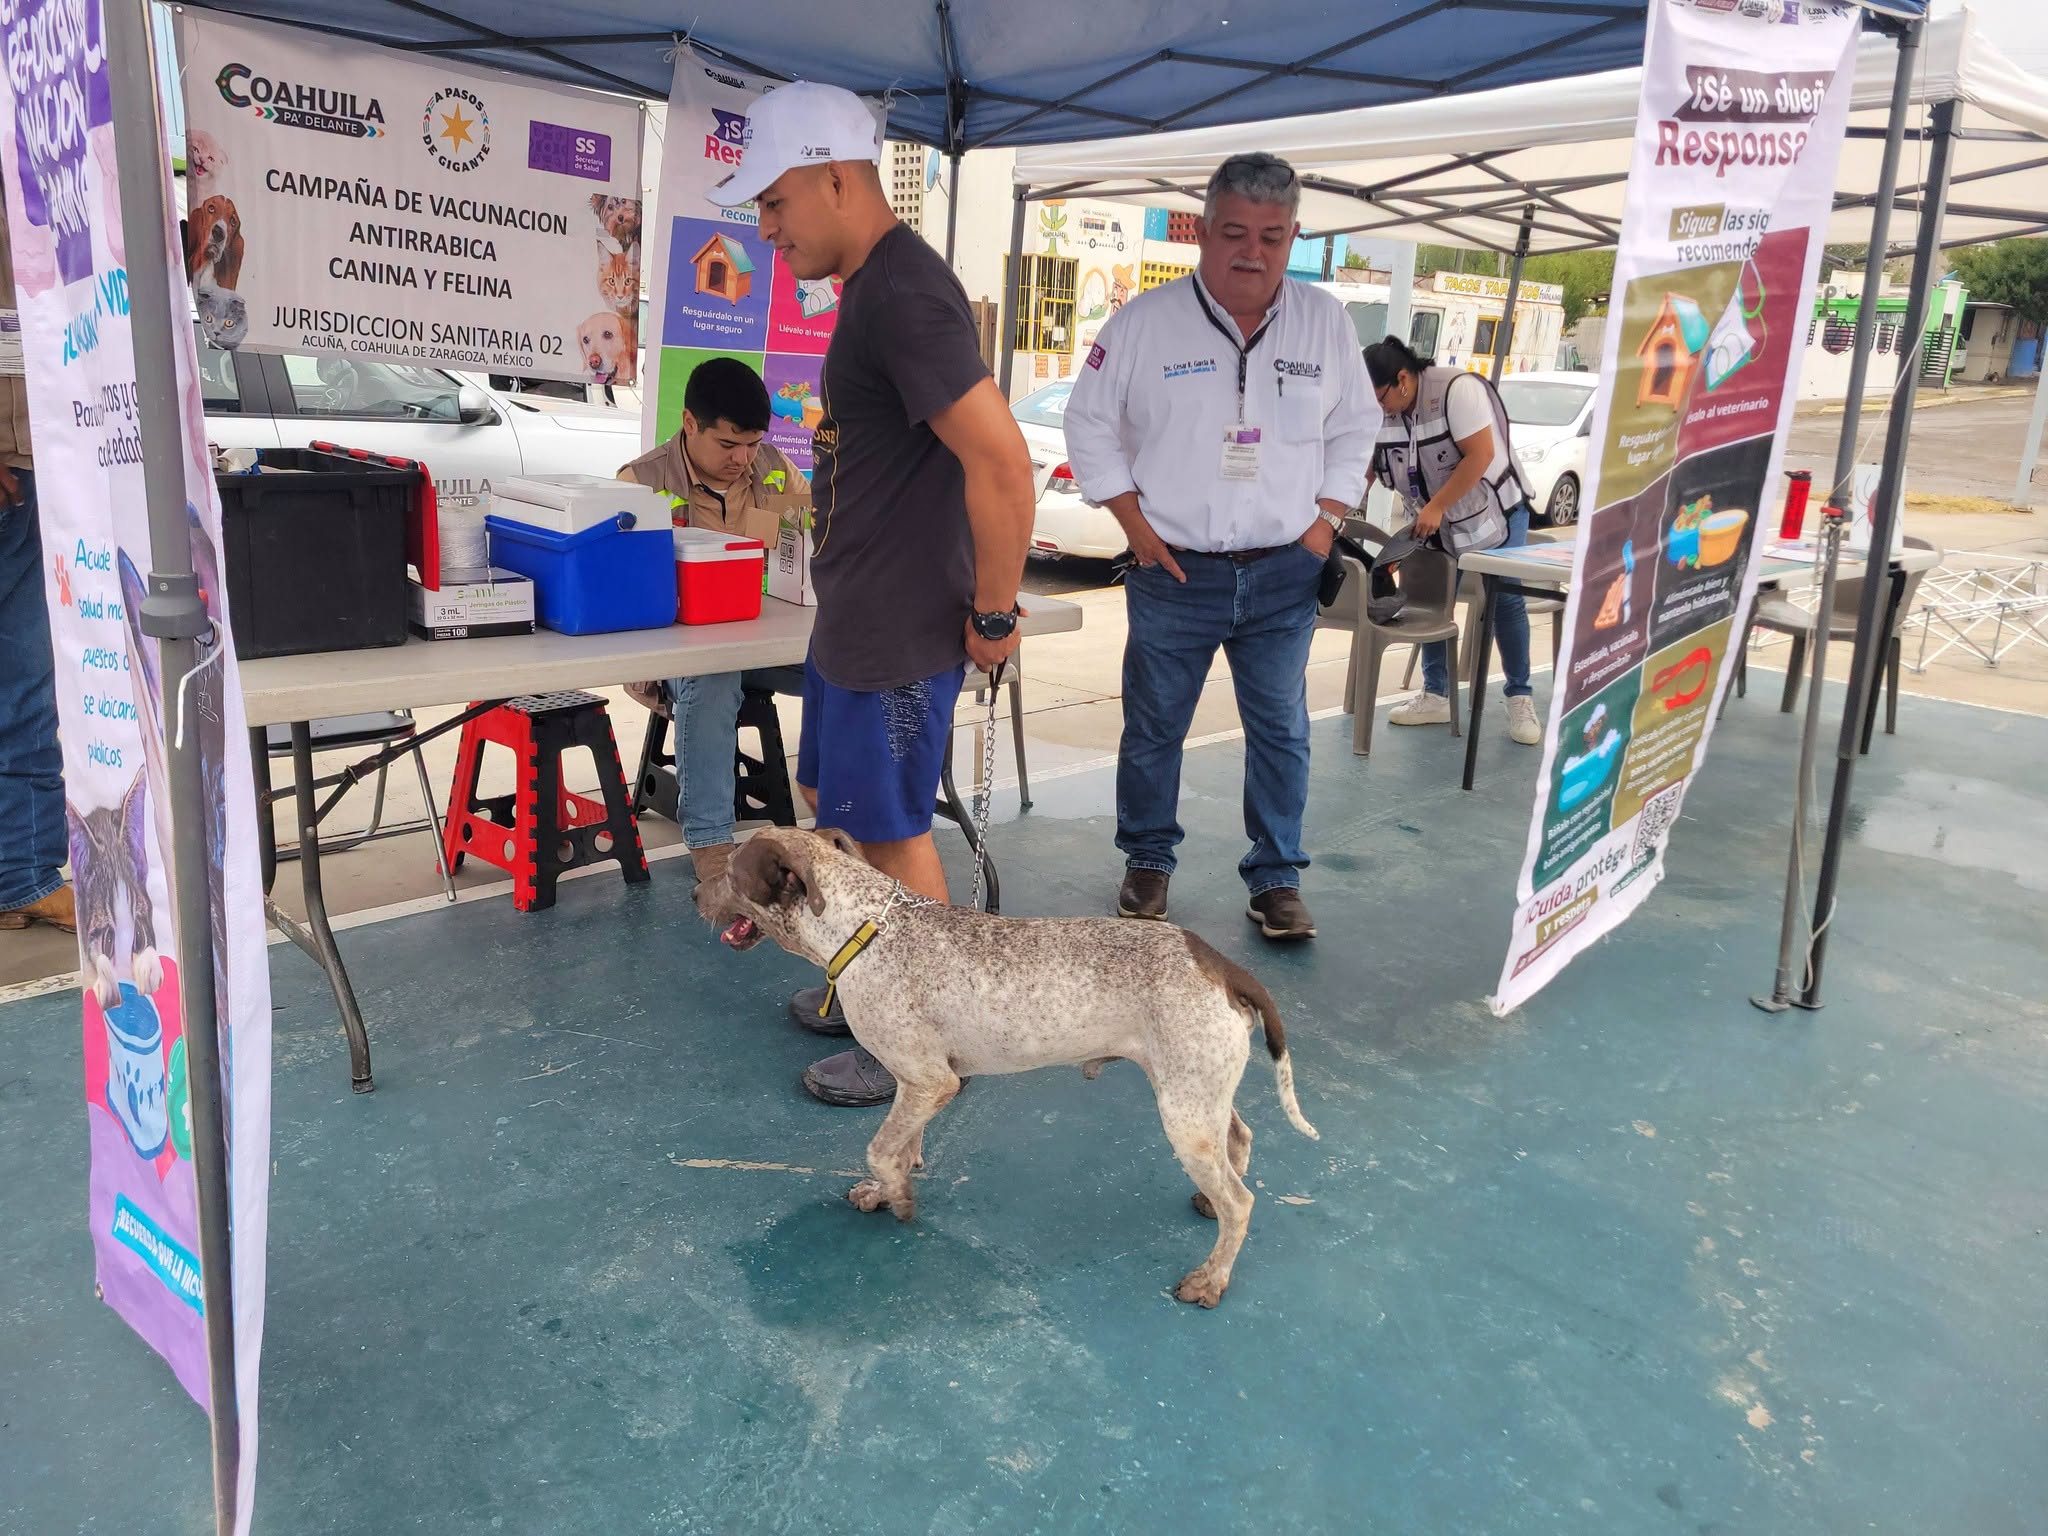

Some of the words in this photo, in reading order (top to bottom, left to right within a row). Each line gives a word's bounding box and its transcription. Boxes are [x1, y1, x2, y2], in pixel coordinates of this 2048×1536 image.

[704, 68, 745, 88] COAHUILA
[215, 63, 385, 123] COAHUILA
[434, 92, 444, 103] A
[445, 87, 484, 112] PASOS
[1691, 75, 1733, 112] ¡Sé
[1740, 87, 1769, 113] un
[305, 117, 358, 134] DELANTE
[423, 134, 438, 156] DE
[438, 143, 490, 172] GIGANTE
[576, 137, 596, 154] SS
[583, 163, 600, 172] Salud
[266, 168, 387, 209] CAMPAÑA
[395, 189, 422, 214] DE
[429, 194, 568, 235] VACUNACION
[1677, 211, 1717, 238] Sigue
[1723, 209, 1744, 231] las
[349, 222, 497, 261] ANTIRRABICA
[329, 257, 418, 288] CANINA
[424, 269, 437, 290] Y
[443, 271, 513, 299] FELINA
[1444, 276, 1481, 293] TACOS
[682, 306, 732, 322] Resguárdalo
[734, 315, 743, 323] en
[745, 317, 755, 325] un
[272, 306, 424, 341] JURISDICCION
[431, 323, 533, 352] SANITARIA
[539, 334, 563, 355] 02
[693, 320, 714, 331] lugar
[716, 325, 743, 335] seguro
[779, 324, 803, 334] Llévalo
[805, 328, 812, 336] al
[302, 334, 347, 351] ACUÑA,
[351, 339, 410, 357] COAHUILA
[412, 345, 426, 358] DE
[429, 347, 489, 366] ZARAGOZA,
[493, 350, 533, 367] MÉXICO
[1274, 358, 1322, 373] COAHUILA
[1707, 405, 1715, 418] al
[1716, 396, 1769, 417] veterinario
[772, 434, 808, 444] Aliméntalo
[1627, 450, 1650, 466] lugar
[75, 538, 111, 571] Acude
[78, 592, 103, 620] salud
[452, 628, 465, 636] 100
[82, 647, 118, 672] puestos
[83, 695, 95, 715] se
[158, 1241, 174, 1271] QUE
[172, 1254, 184, 1282] LA
